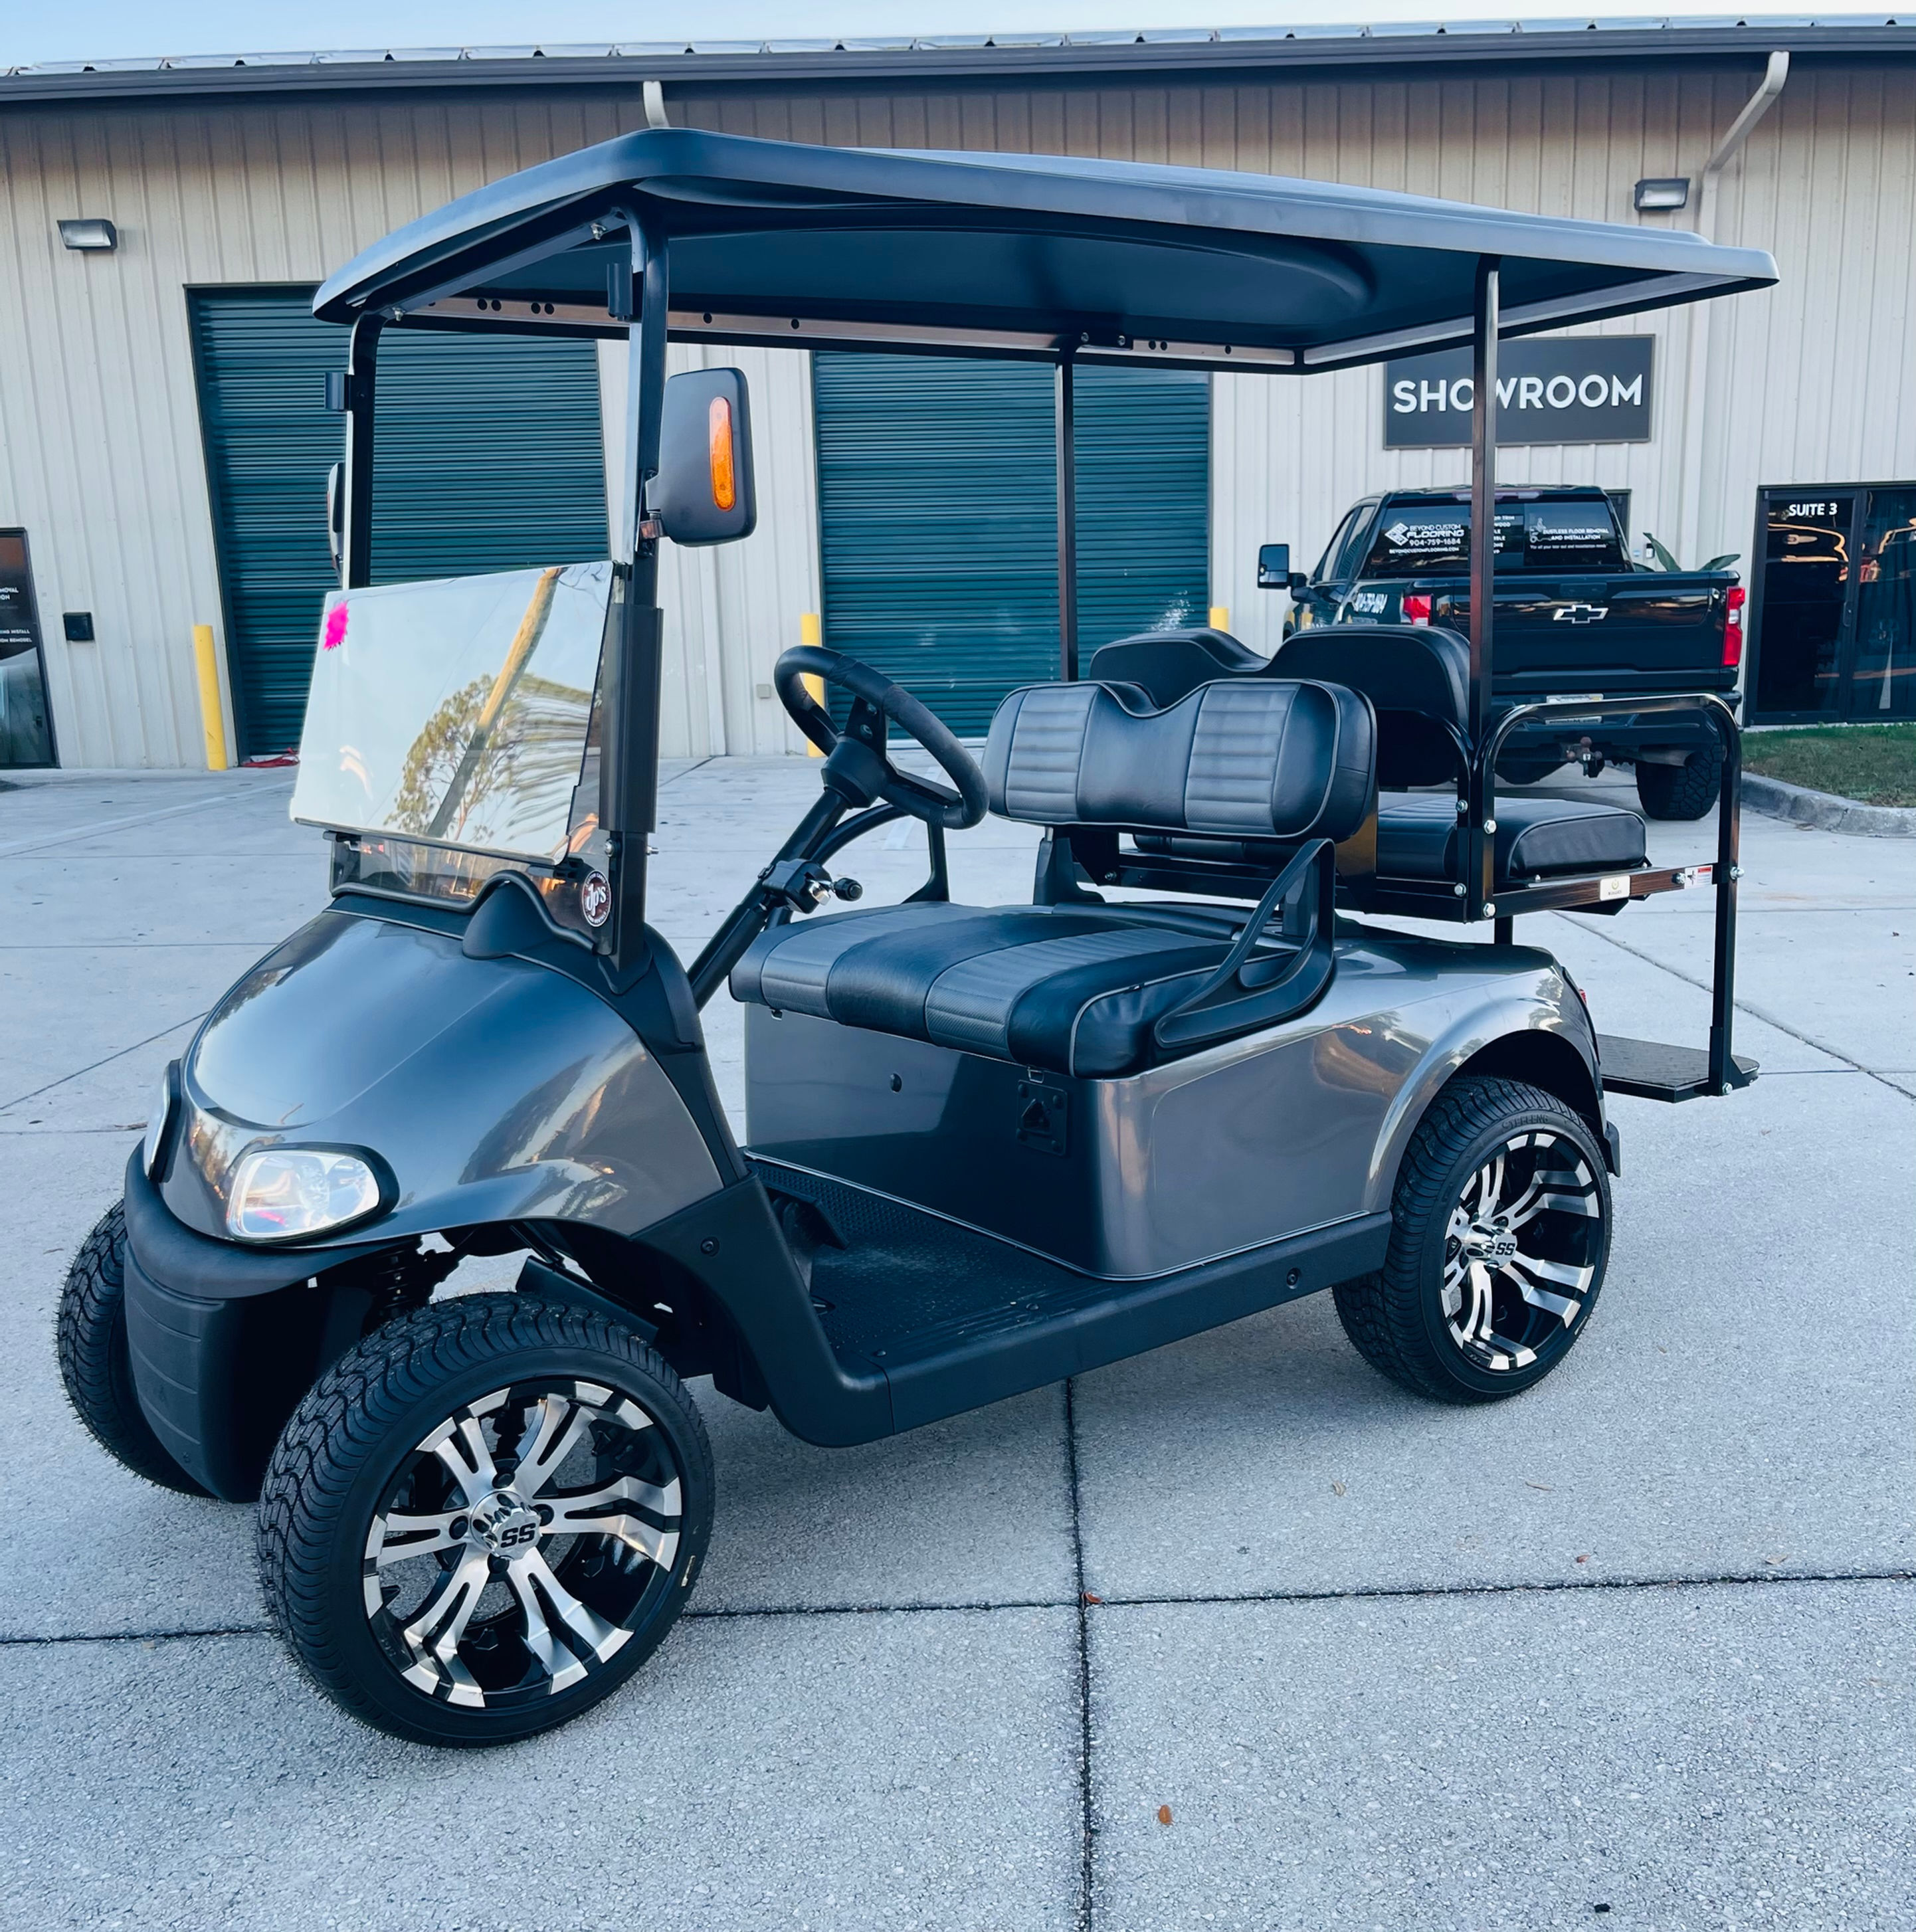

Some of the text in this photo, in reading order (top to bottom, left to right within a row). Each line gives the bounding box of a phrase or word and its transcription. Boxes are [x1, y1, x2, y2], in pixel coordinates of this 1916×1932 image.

[1393, 373, 1643, 413] SHOWROOM
[1788, 502, 1838, 516] SUITE 3
[1406, 530, 1465, 538] FLOORING
[1495, 1242, 1515, 1256] SS
[500, 1523, 536, 1548] SS
